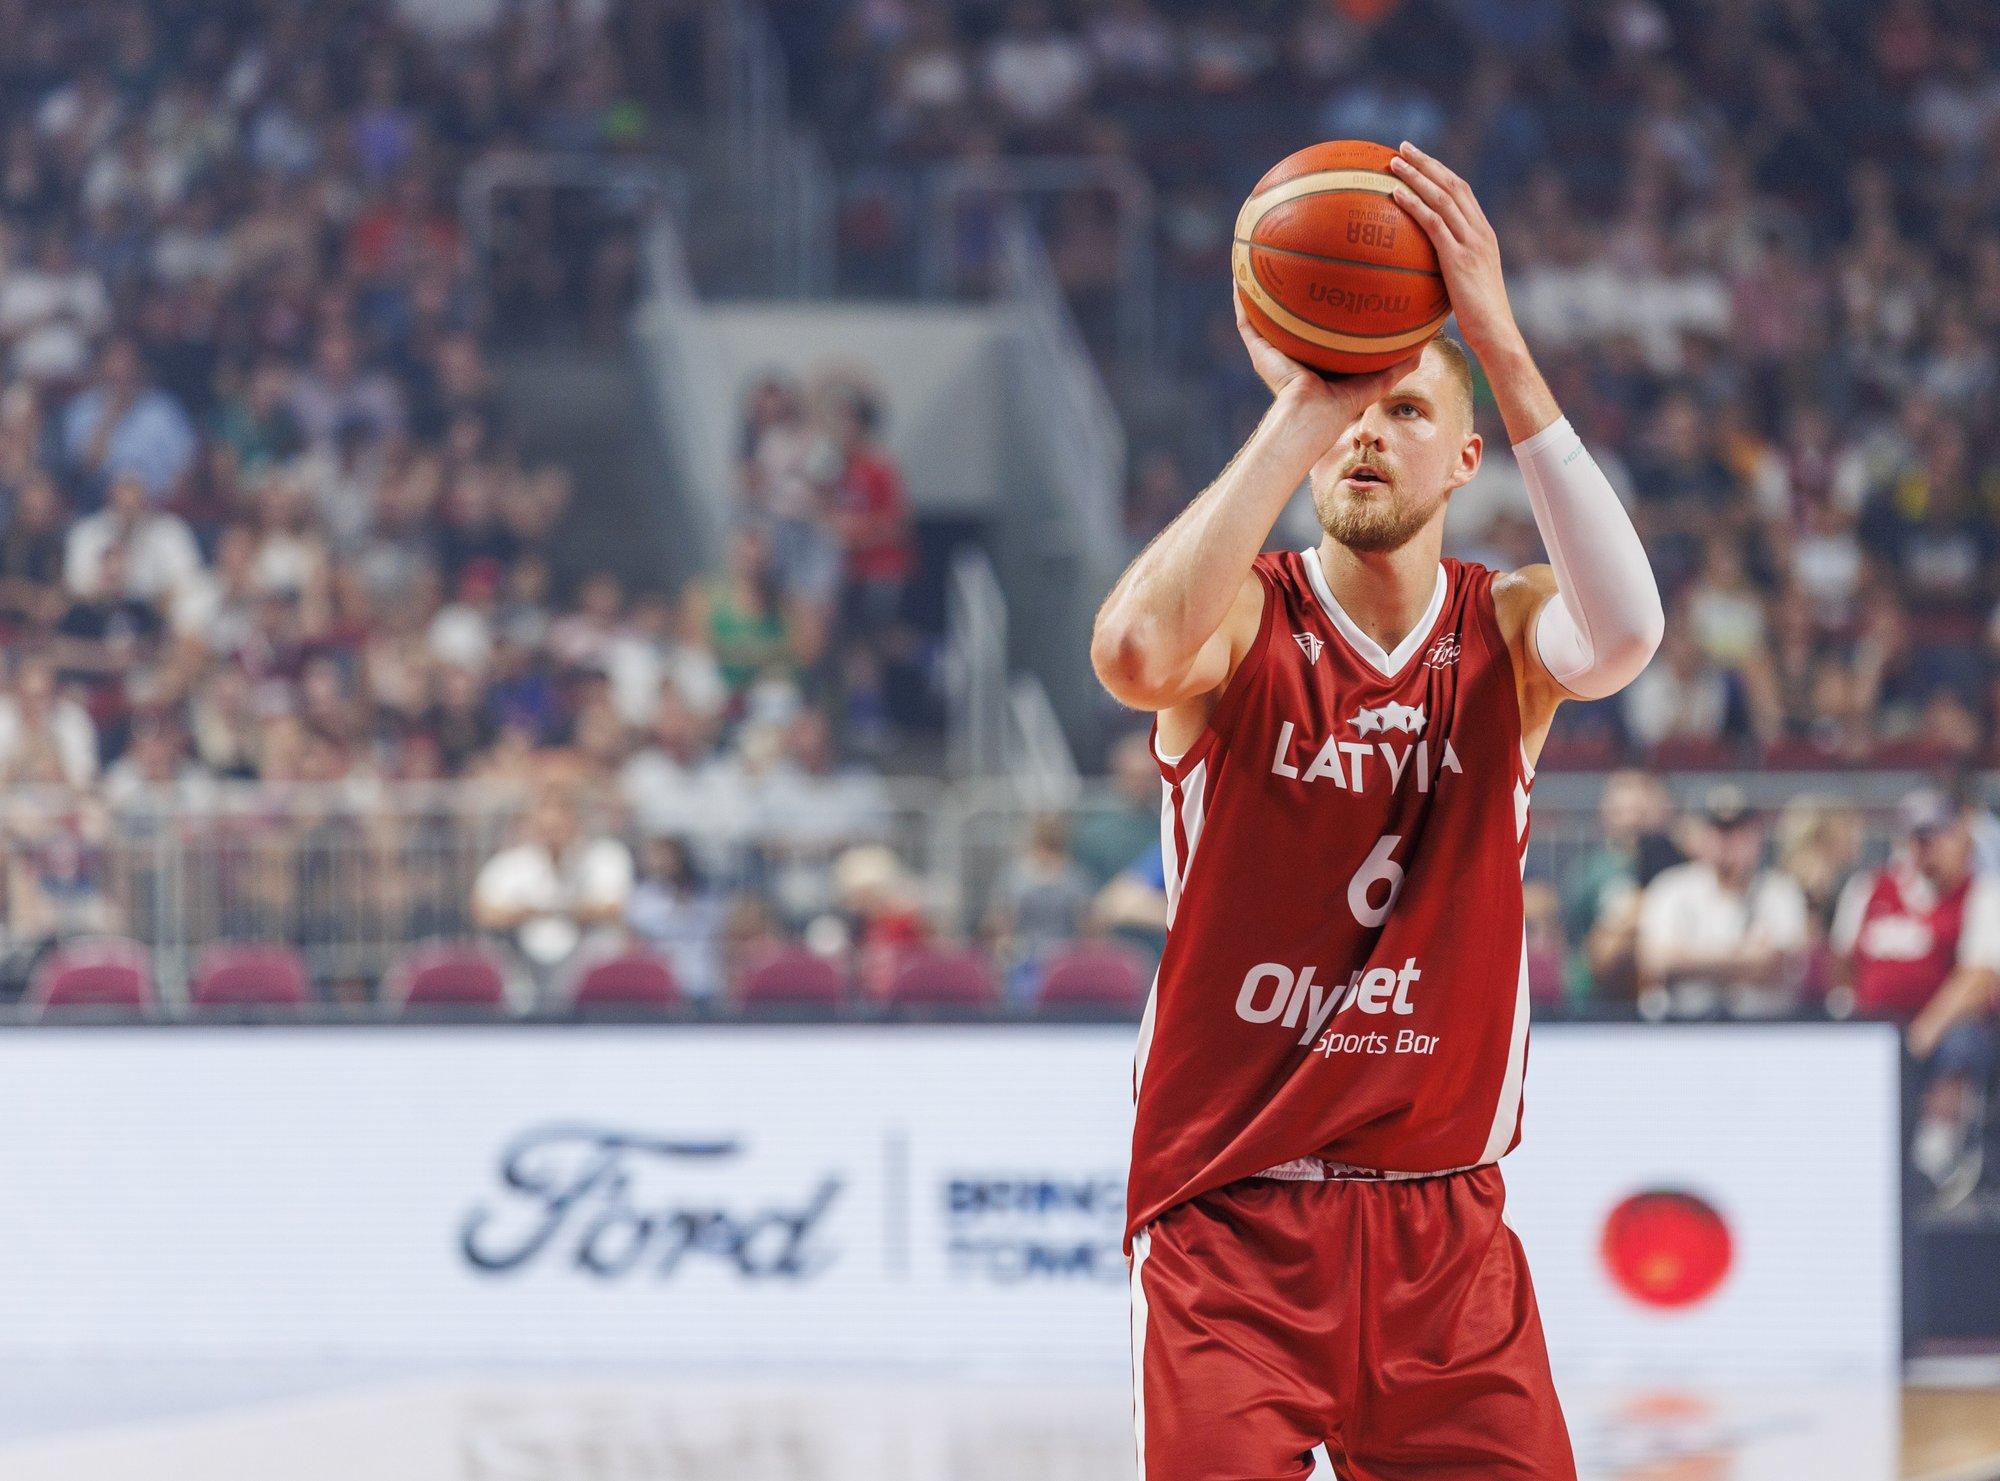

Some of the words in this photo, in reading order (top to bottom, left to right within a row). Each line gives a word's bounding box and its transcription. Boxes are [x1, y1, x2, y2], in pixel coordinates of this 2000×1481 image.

[1346, 222, 1397, 250] FIBA
[1309, 282, 1411, 315] molten
[1271, 720, 1463, 796] LATVIA
[1347, 834, 1406, 928] 6
[1313, 1028, 1389, 1059] Sports
[1394, 1029, 1440, 1055] Bar
[462, 1118, 850, 1284] Ford
